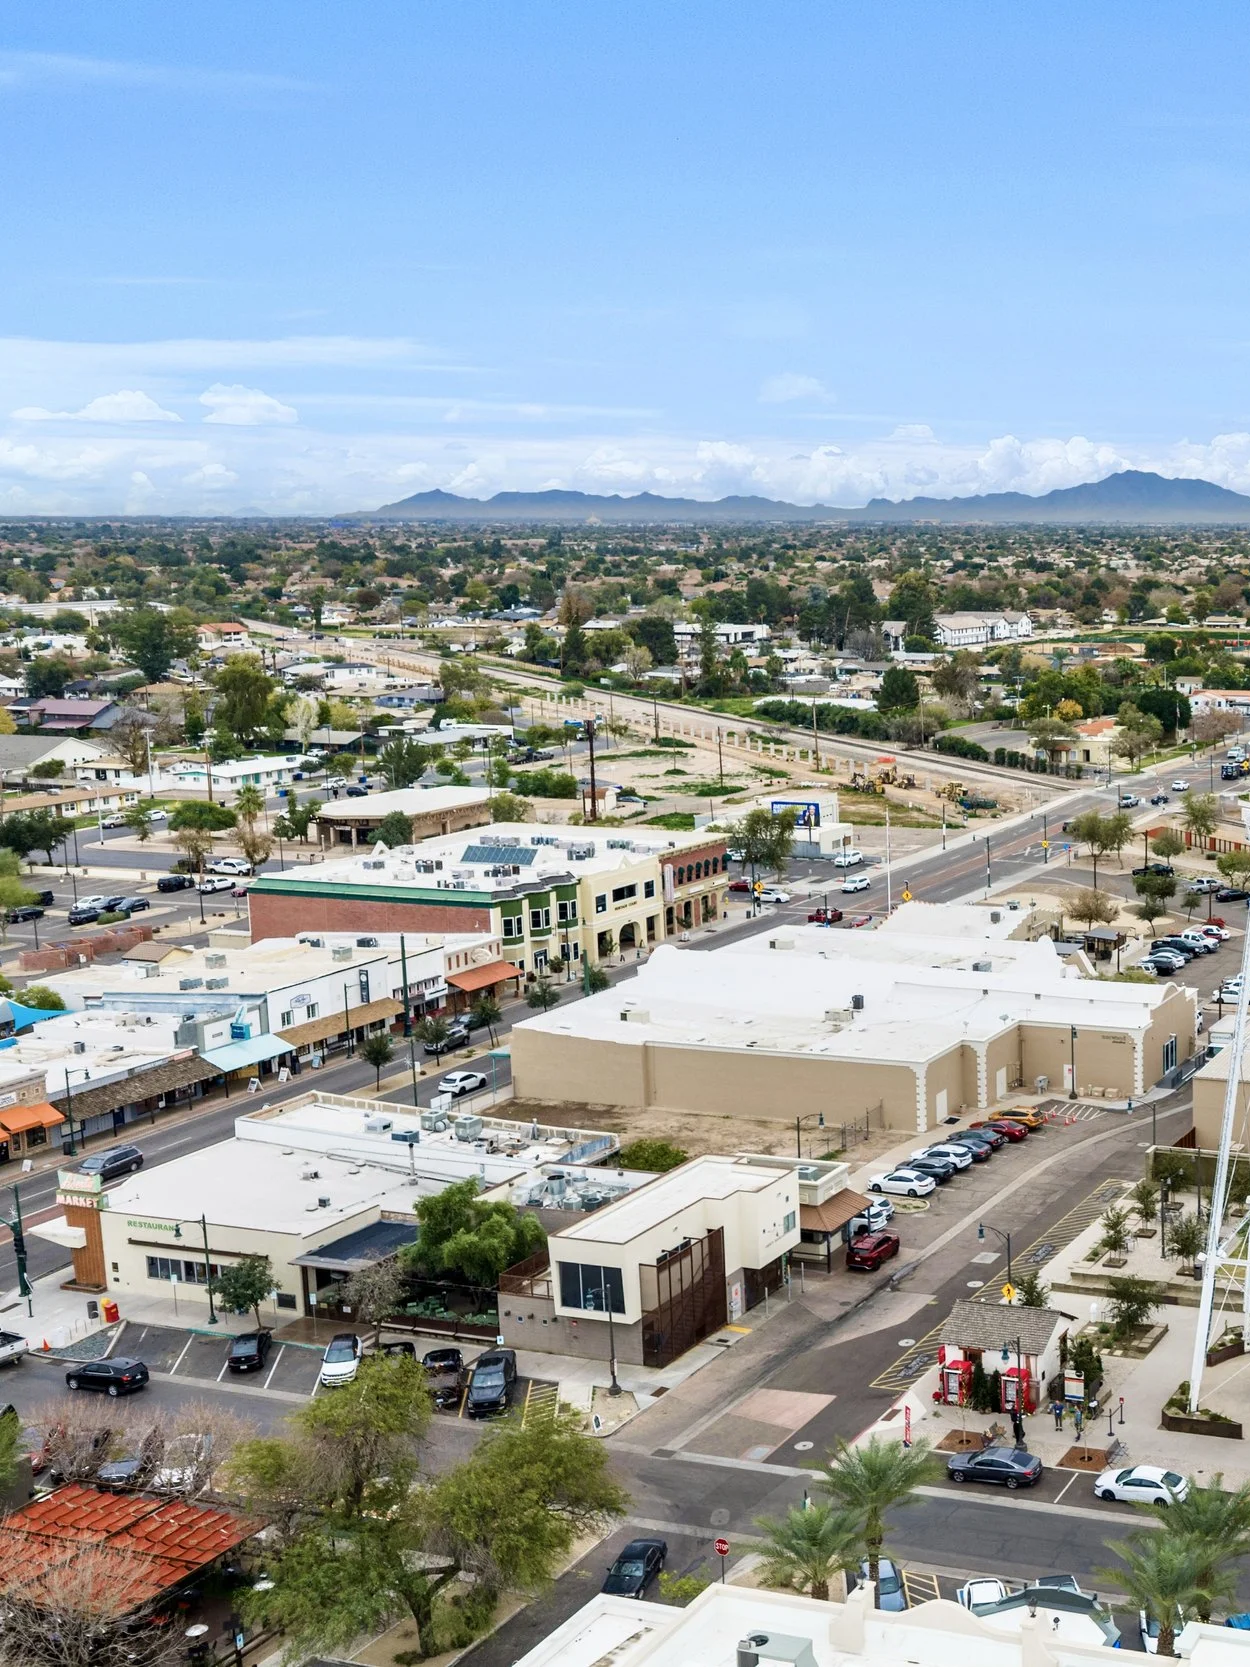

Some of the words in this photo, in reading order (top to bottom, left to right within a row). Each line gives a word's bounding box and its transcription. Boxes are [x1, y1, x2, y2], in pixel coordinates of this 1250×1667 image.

[56, 1194, 98, 1209] MARKET
[127, 1219, 176, 1232] RESTAURAN
[715, 1542, 729, 1551] STOP
